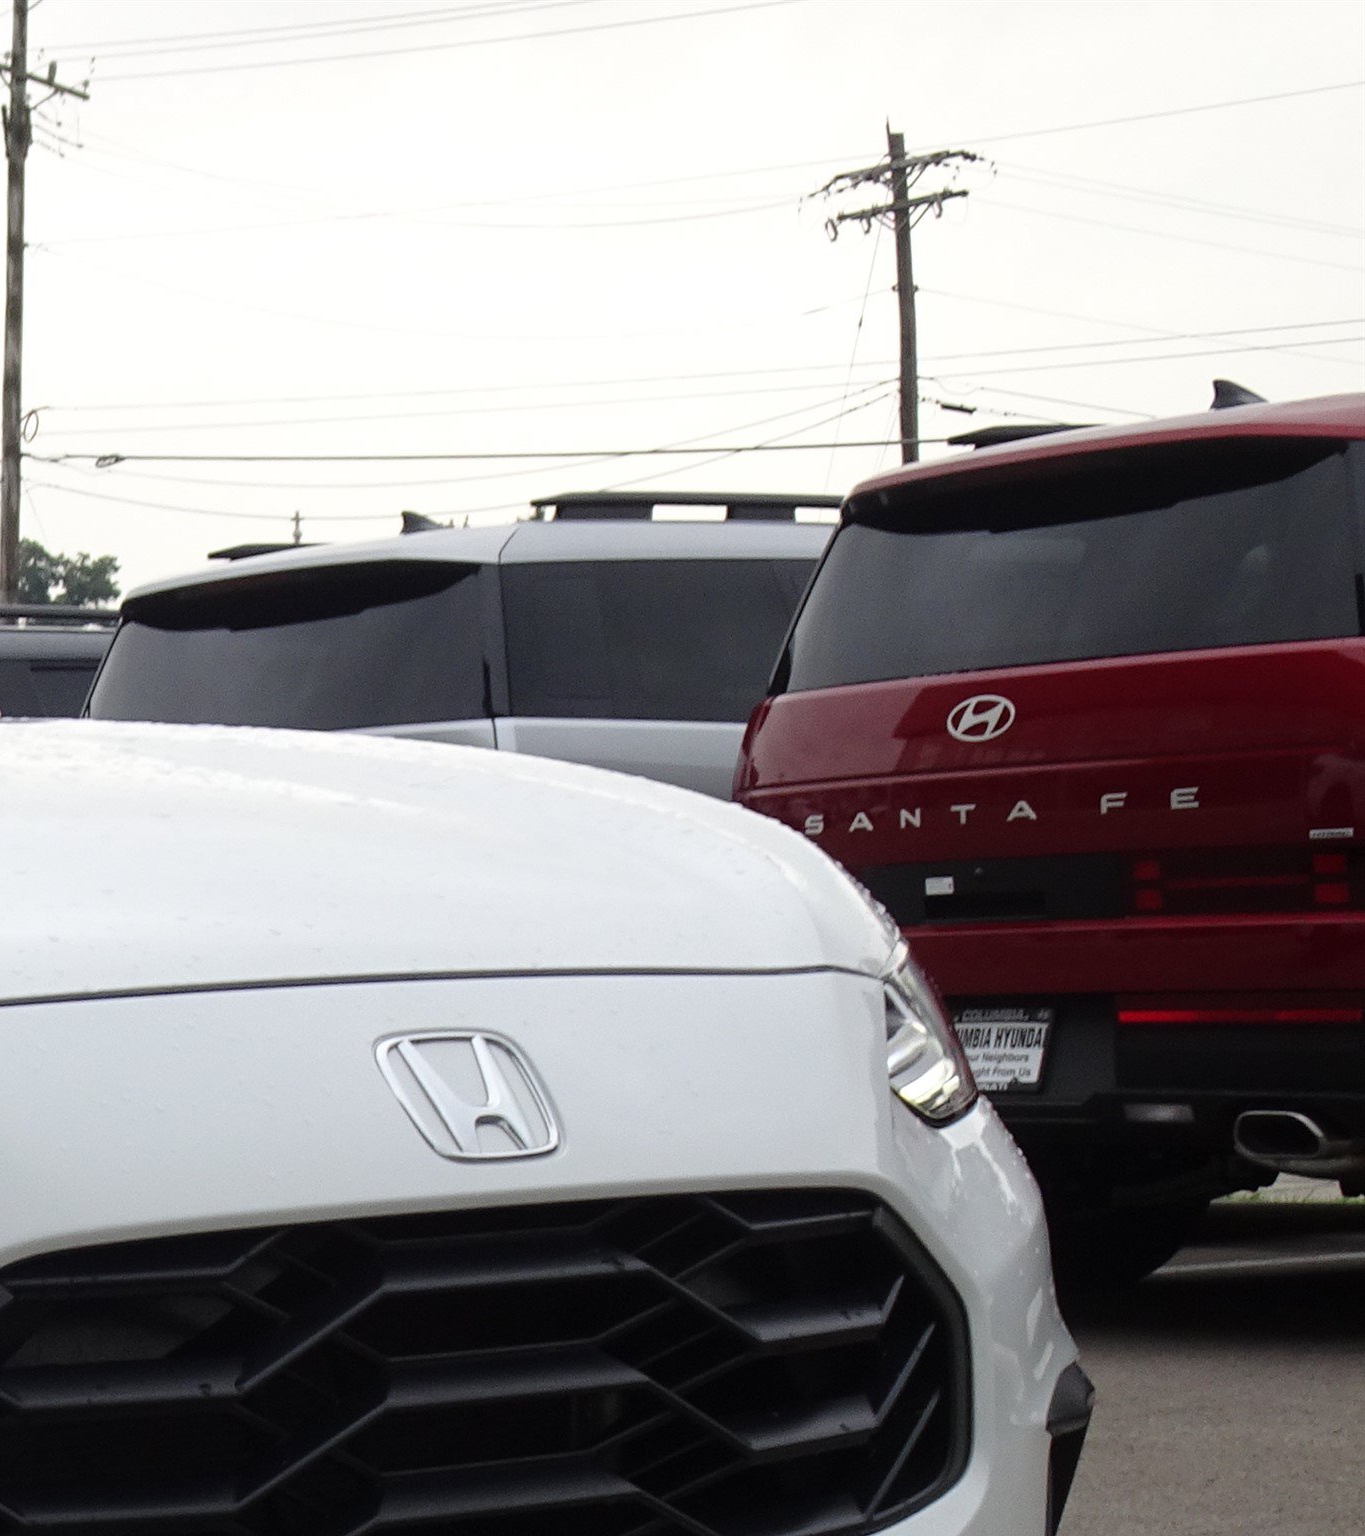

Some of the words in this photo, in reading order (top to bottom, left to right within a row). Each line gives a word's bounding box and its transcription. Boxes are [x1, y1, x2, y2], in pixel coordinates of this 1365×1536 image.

[804, 800, 1038, 836] SANTA
[1099, 786, 1200, 815] FE
[957, 1027, 992, 1049] UMBIA
[982, 1053, 1030, 1063] Neighbors
